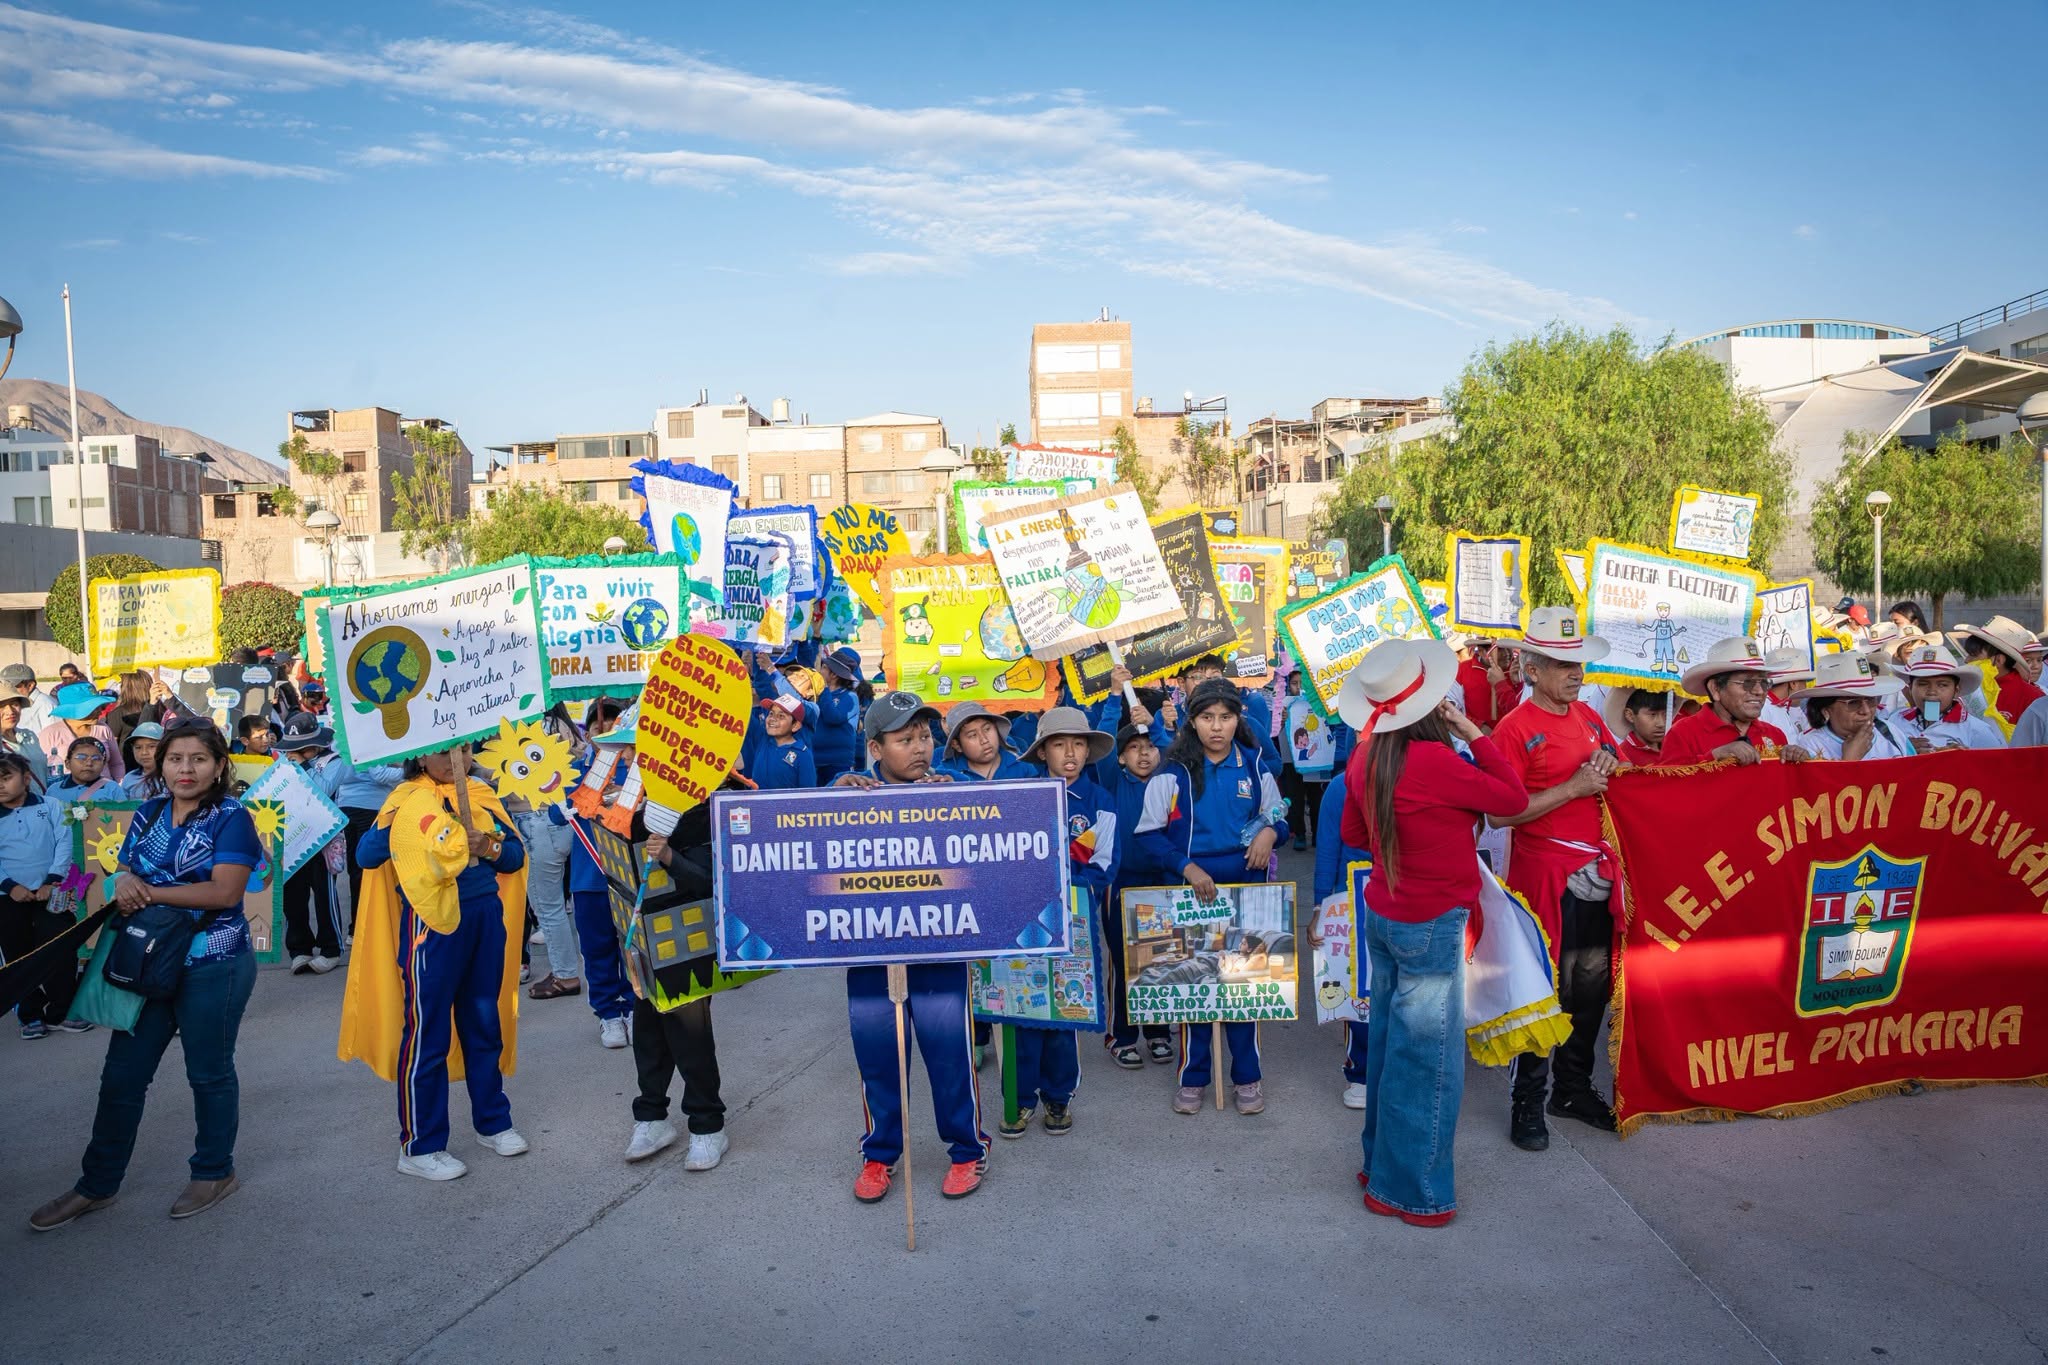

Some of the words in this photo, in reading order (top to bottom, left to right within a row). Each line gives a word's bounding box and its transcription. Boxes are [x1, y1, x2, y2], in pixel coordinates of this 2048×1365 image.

[1033, 452, 1088, 469] AHORRO
[830, 504, 860, 534] NO
[867, 509, 898, 535] ME
[847, 532, 888, 555] USAS
[994, 526, 1014, 544] LA
[1063, 526, 1088, 544] HOY
[539, 575, 587, 600] Para
[607, 577, 654, 598] vivir
[726, 569, 760, 586] ERGIA
[98, 585, 136, 600] PARA
[137, 583, 170, 598] VIVIR
[122, 600, 146, 612] CON
[705, 605, 719, 622] EL
[1307, 599, 1347, 632] Para
[1349, 581, 1386, 611] vivir
[342, 598, 438, 640] Ahorremos
[504, 609, 518, 626] la
[1331, 613, 1360, 635] con
[1324, 623, 1379, 660] alegría
[460, 645, 480, 670] luz
[483, 640, 495, 659] al
[550, 656, 593, 676] ORRA
[675, 635, 695, 656] EL
[696, 645, 724, 671] SOL
[725, 660, 748, 681] NO
[435, 667, 504, 702] Aprovecha
[510, 660, 526, 678] la
[644, 691, 665, 710] SU
[647, 675, 745, 738] APROVECHA
[289, 725, 299, 735] A
[432, 708, 457, 730] luz
[638, 715, 727, 773] CUIDEMOS
[670, 749, 691, 772] LA
[637, 752, 707, 804] ENERGIA
[776, 808, 893, 829] INSTITUCIÓN
[899, 805, 1001, 823] EDUCATIVA
[1756, 782, 1898, 866] SIMON
[732, 841, 818, 872] DANIEL
[826, 836, 937, 870] BECERRA
[945, 830, 1049, 863] OCAMPO
[839, 873, 943, 890] MOQUEGUA
[1176, 900, 1193, 910] ME
[1177, 907, 1232, 922] APAGAME
[1887, 891, 1912, 917] E
[806, 902, 980, 941] PRIMARIA
[1828, 949, 1853, 963] SIMON
[1854, 946, 1888, 960] BOLIVAR
[1128, 986, 1181, 999] APAGA
[1188, 985, 1210, 997] LO
[1216, 984, 1250, 997] QUE
[1256, 983, 1279, 995] NO
[1813, 984, 1884, 1000] MOQUEGUA
[1128, 998, 1169, 1011] USAS
[1216, 995, 1286, 1009] ILUMINA
[1128, 1013, 1148, 1024] EL
[1153, 1010, 1218, 1023] FUTURO
[1221, 1008, 1295, 1021] MAÑANA
[1686, 1031, 1794, 1088] NIVEL
[1808, 1005, 2024, 1064] PRIMARIA
